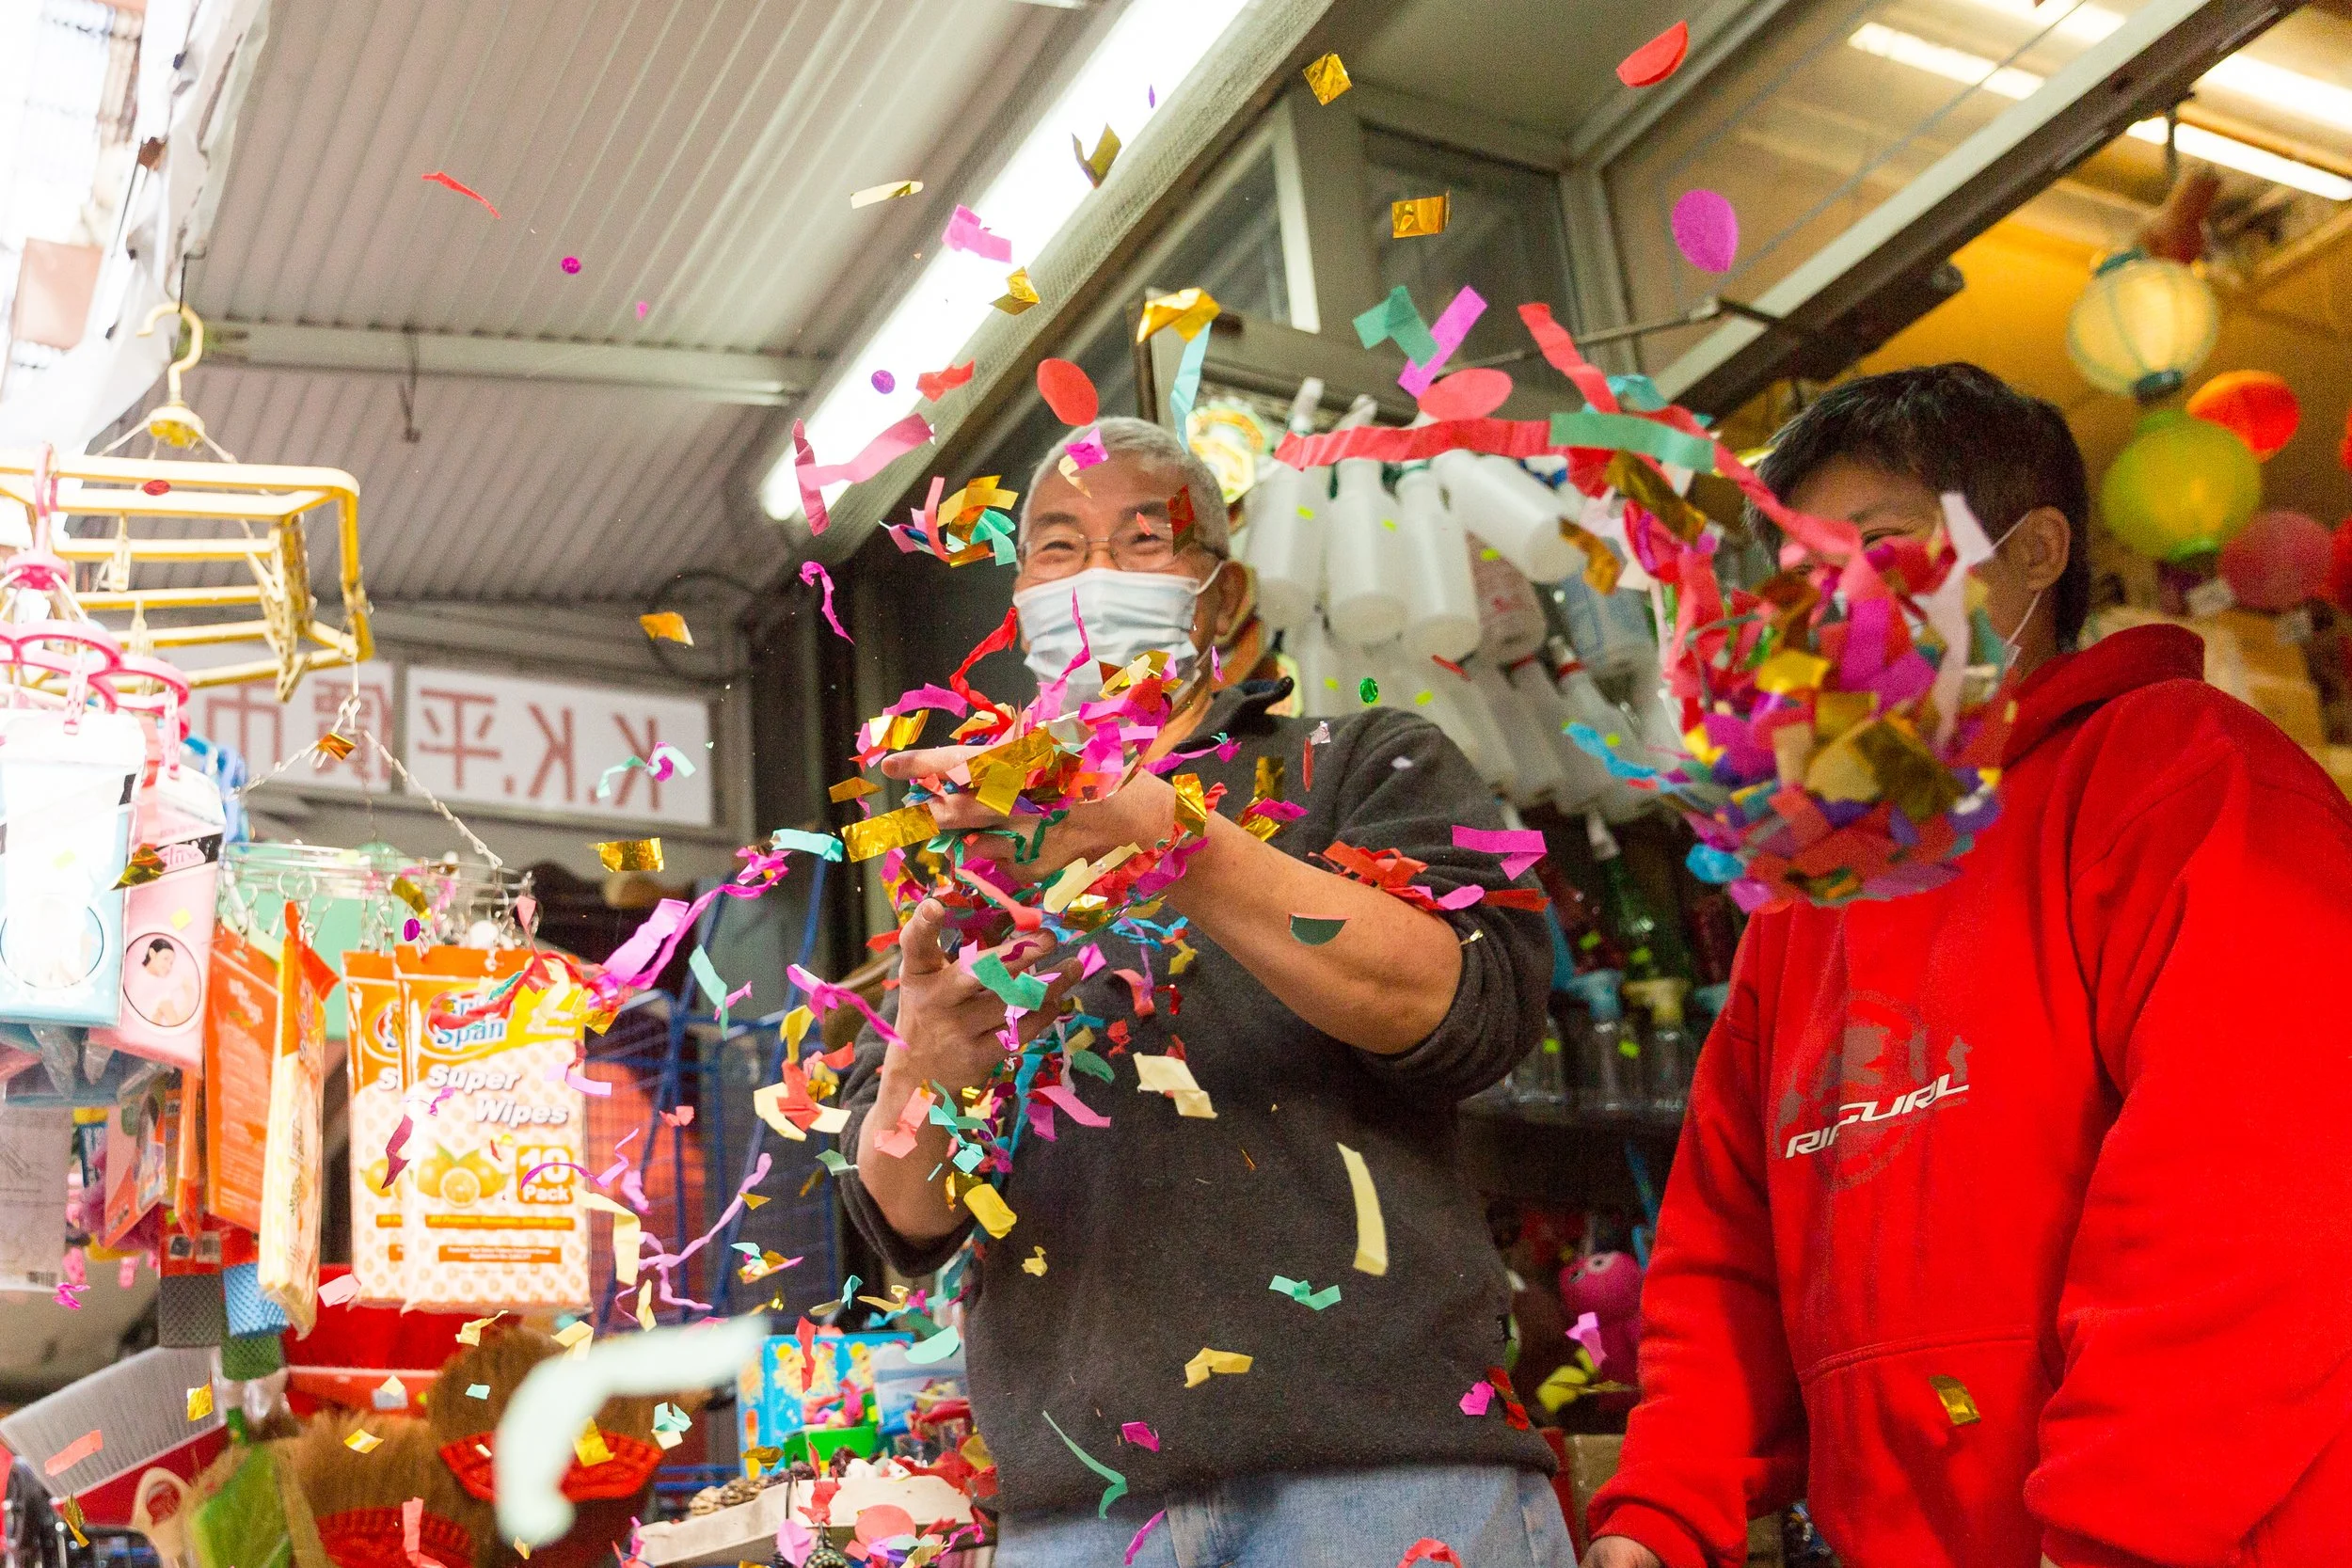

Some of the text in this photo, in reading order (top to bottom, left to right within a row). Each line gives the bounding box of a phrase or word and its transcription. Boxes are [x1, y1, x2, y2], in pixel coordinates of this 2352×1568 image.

[435, 1019, 506, 1048] Span
[426, 1064, 522, 1094] Super
[475, 1097, 569, 1129] Wipes
[519, 1148, 571, 1184] 10
[522, 1185, 570, 1203] Pack
